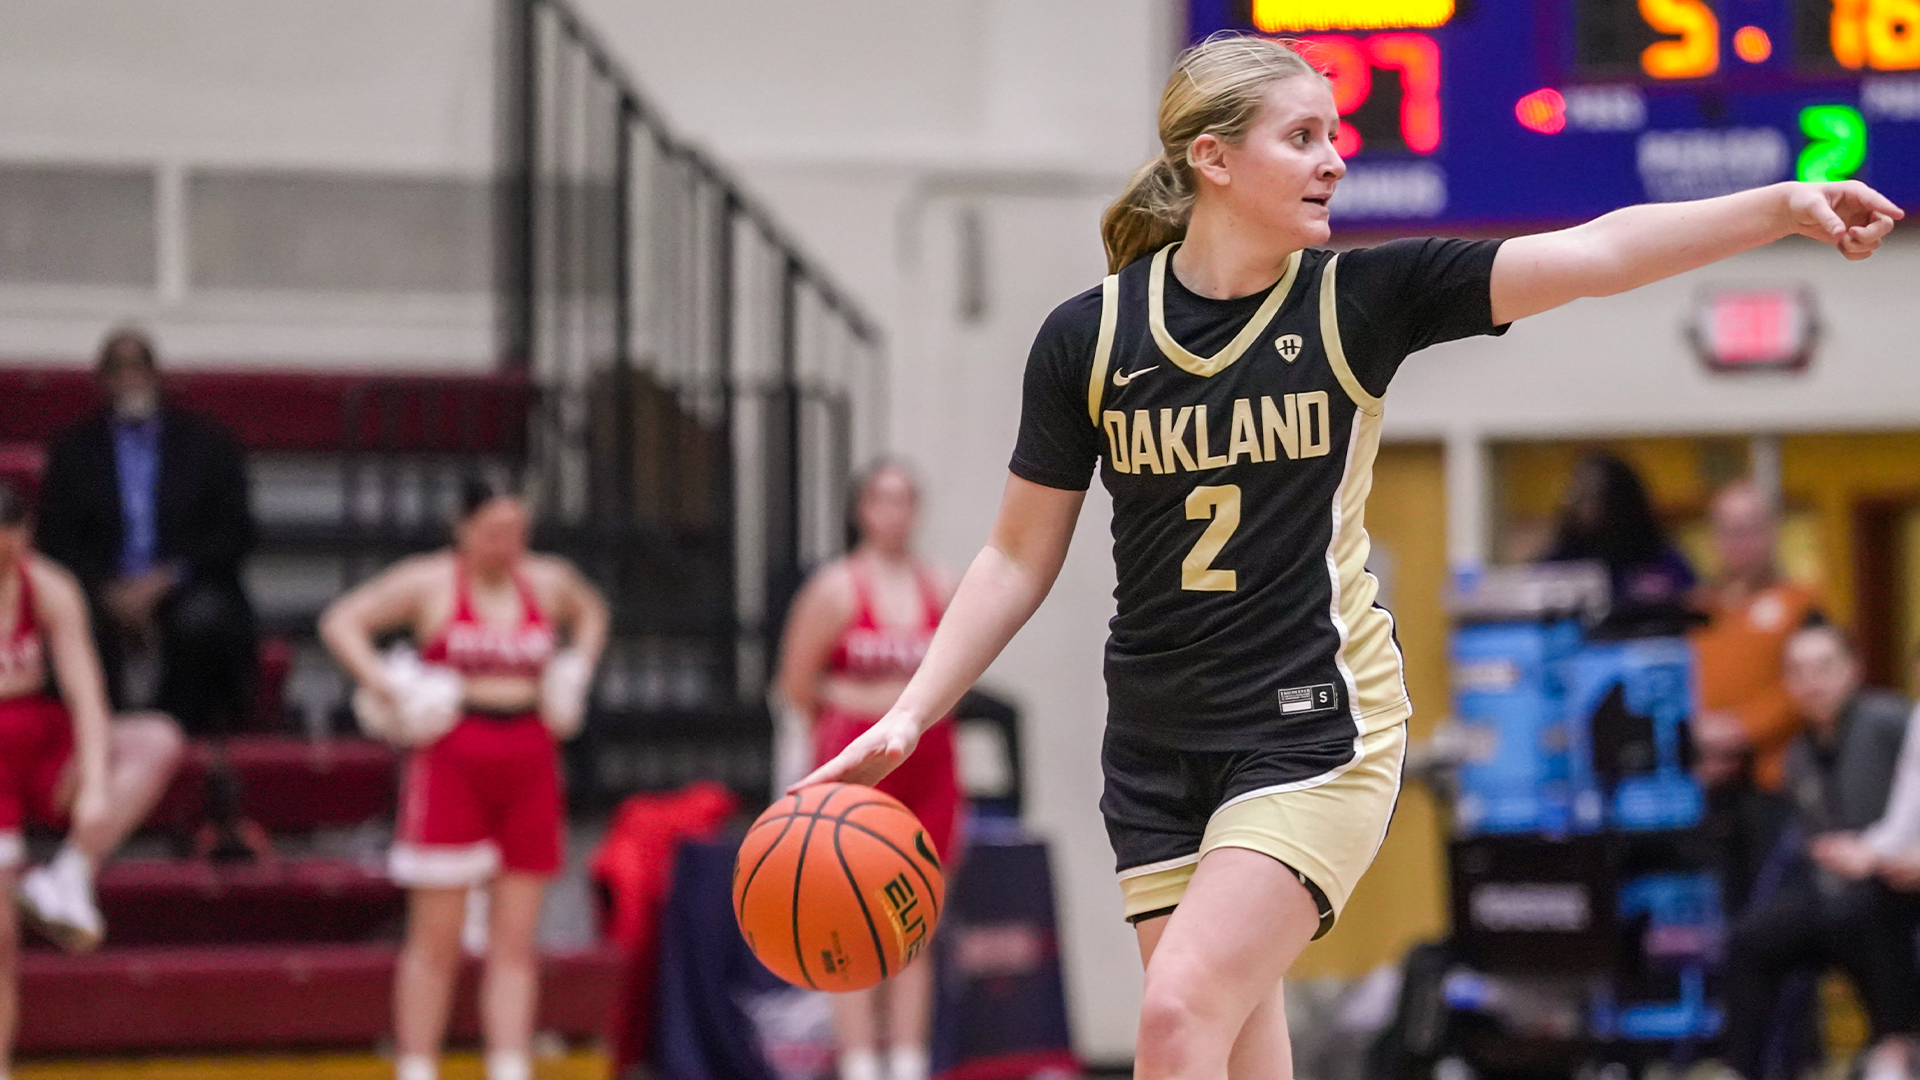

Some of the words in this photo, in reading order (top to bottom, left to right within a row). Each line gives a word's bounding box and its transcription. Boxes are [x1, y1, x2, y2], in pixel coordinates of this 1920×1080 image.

[1103, 390, 1331, 475] OAKLAND
[1181, 484, 1241, 592] 2
[1319, 690, 1328, 703] S
[884, 871, 926, 964] ELITE
